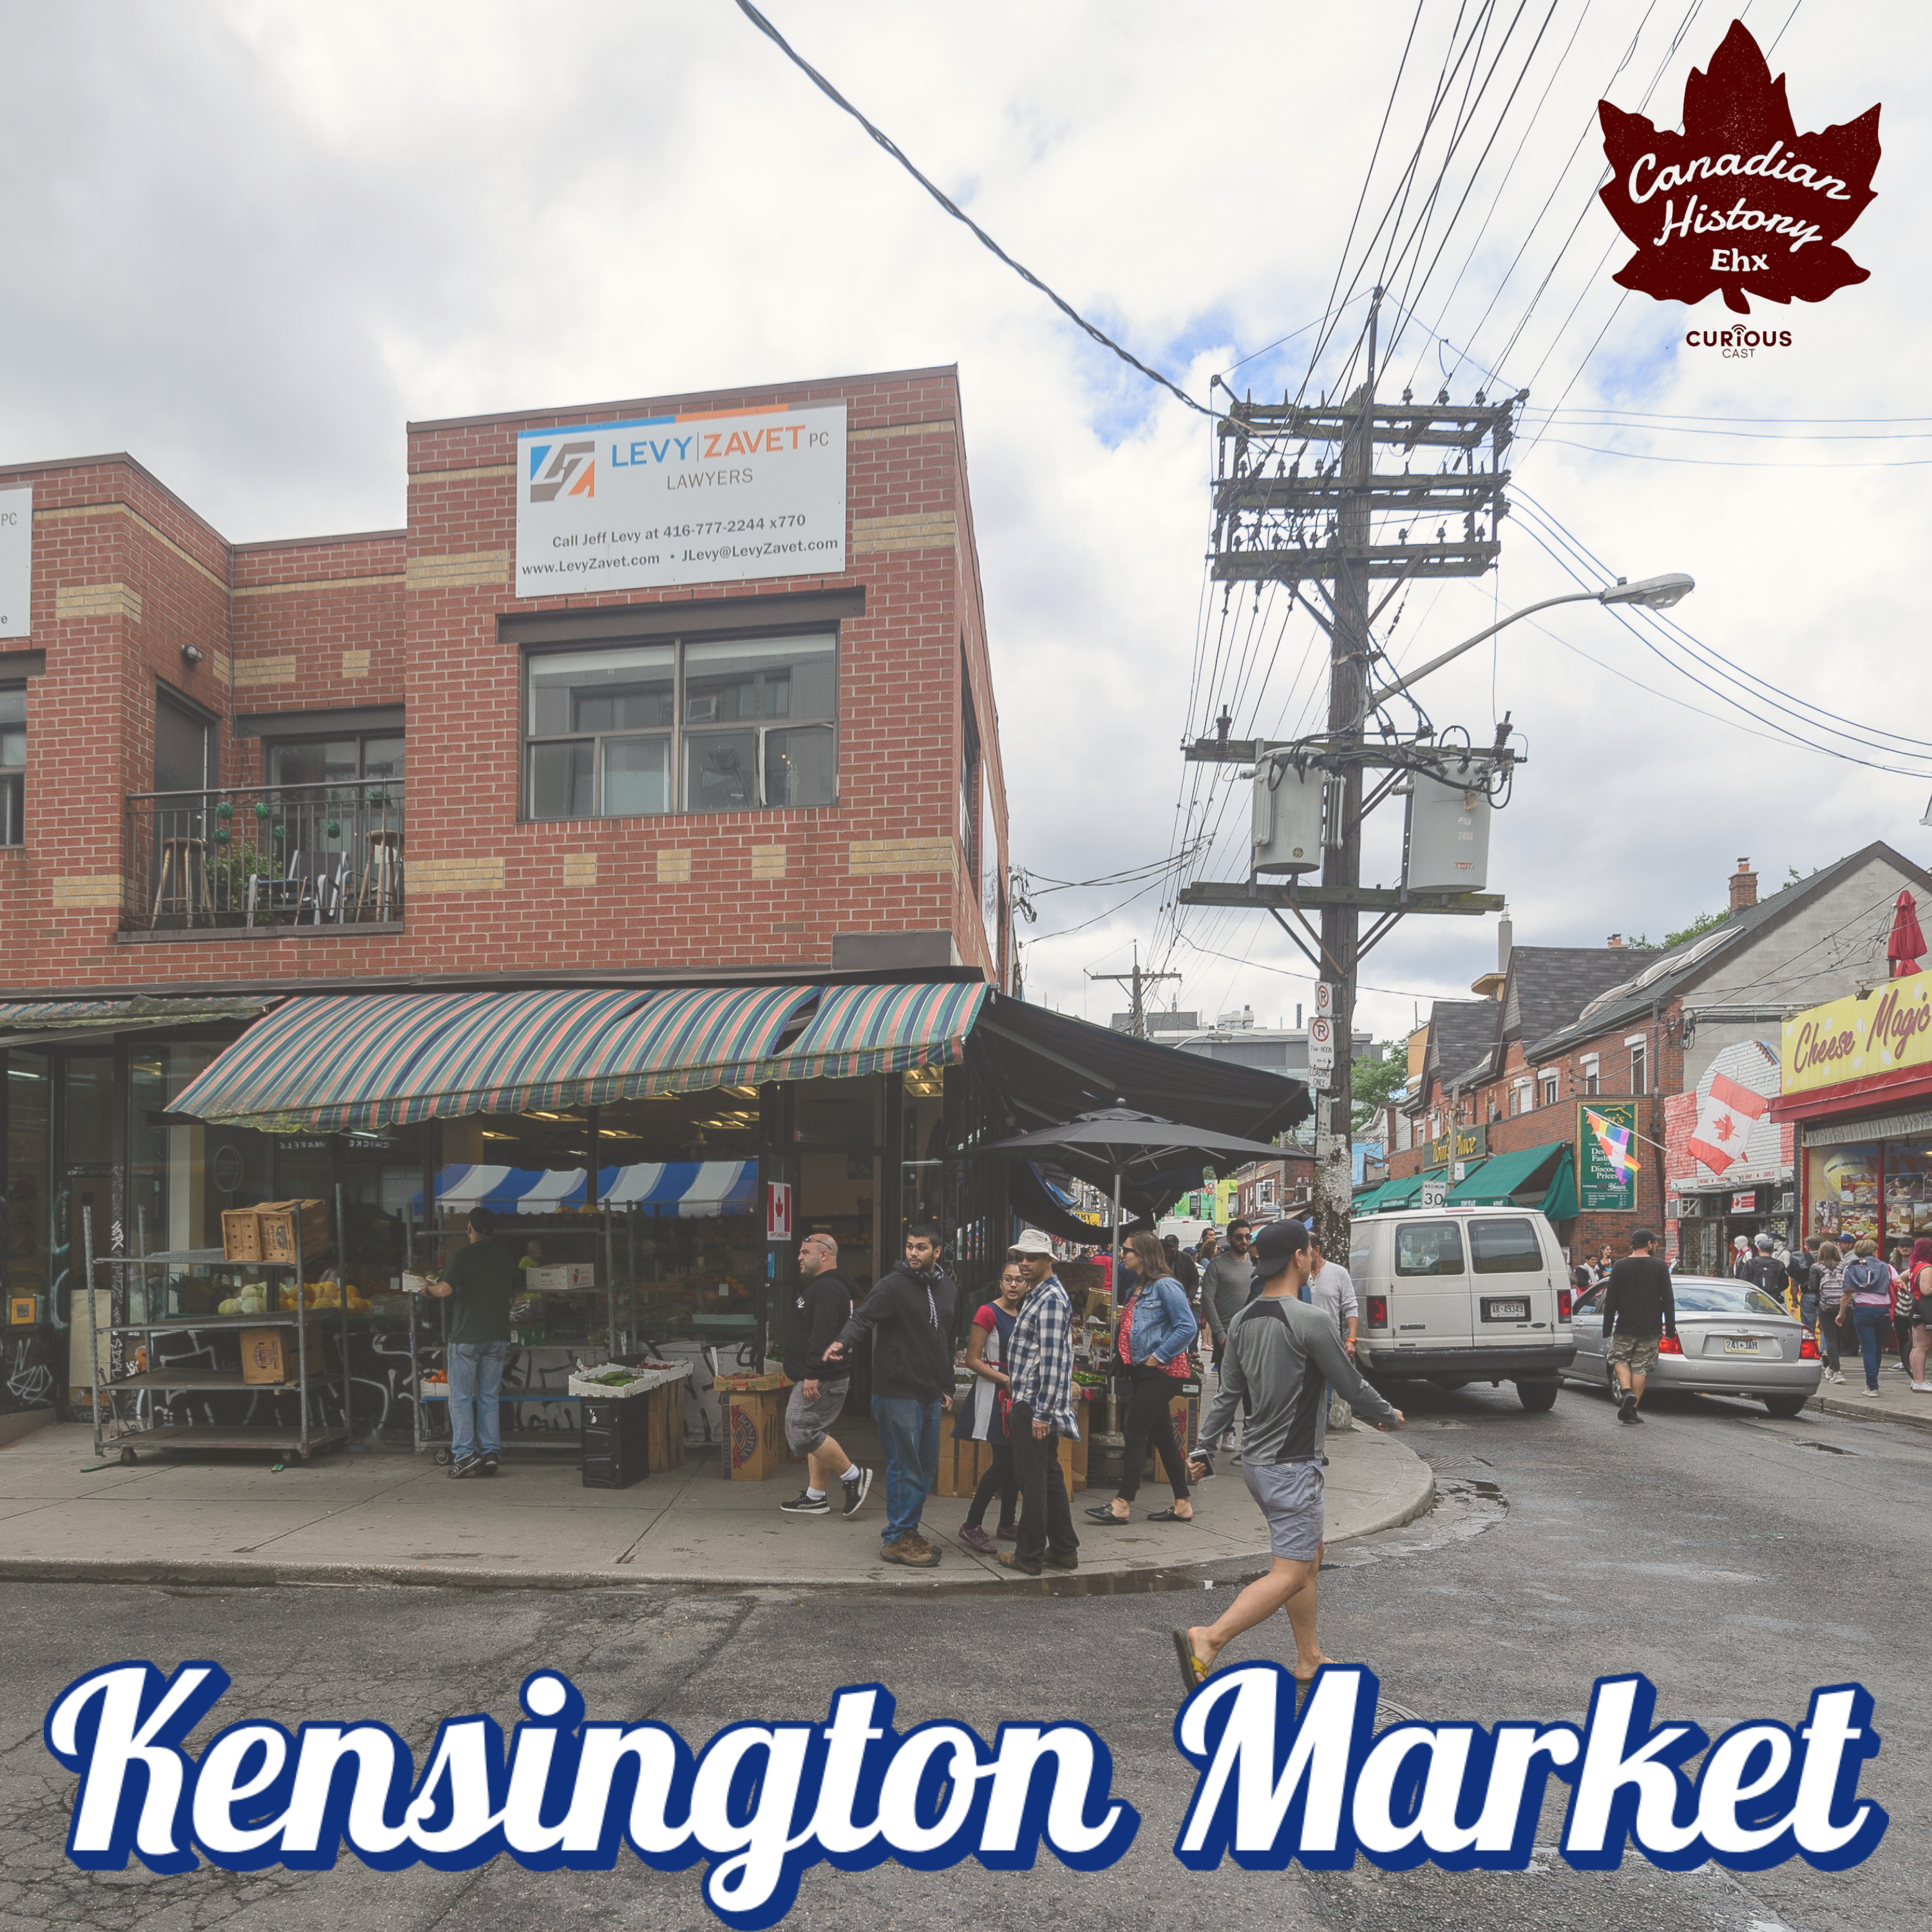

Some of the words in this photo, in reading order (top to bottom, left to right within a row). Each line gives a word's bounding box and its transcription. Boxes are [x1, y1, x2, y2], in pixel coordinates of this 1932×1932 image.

[611, 436, 693, 468] LEVY
[703, 424, 806, 459] ZAVET
[810, 431, 829, 448] PC
[667, 468, 753, 491] LAWYERS
[1, 512, 17, 526] PC
[553, 535, 578, 549] Call
[582, 531, 607, 546] Jeff
[611, 530, 641, 546] Levy
[645, 529, 659, 540] at
[663, 518, 765, 538] 416-777-2244
[770, 515, 806, 529] x770
[522, 553, 660, 575] www.LevyZavet.com
[682, 538, 838, 562] JLevy@LevyZavet.com
[1794, 1021, 1856, 1074] Cheese
[1866, 988, 1931, 1059] Magic
[1424, 1193, 1443, 1206] 30
[1607, 1182, 1627, 1191] Years
[1504, 1304, 1523, 1313] 49349
[738, 1414, 755, 1458] BONIPAK
